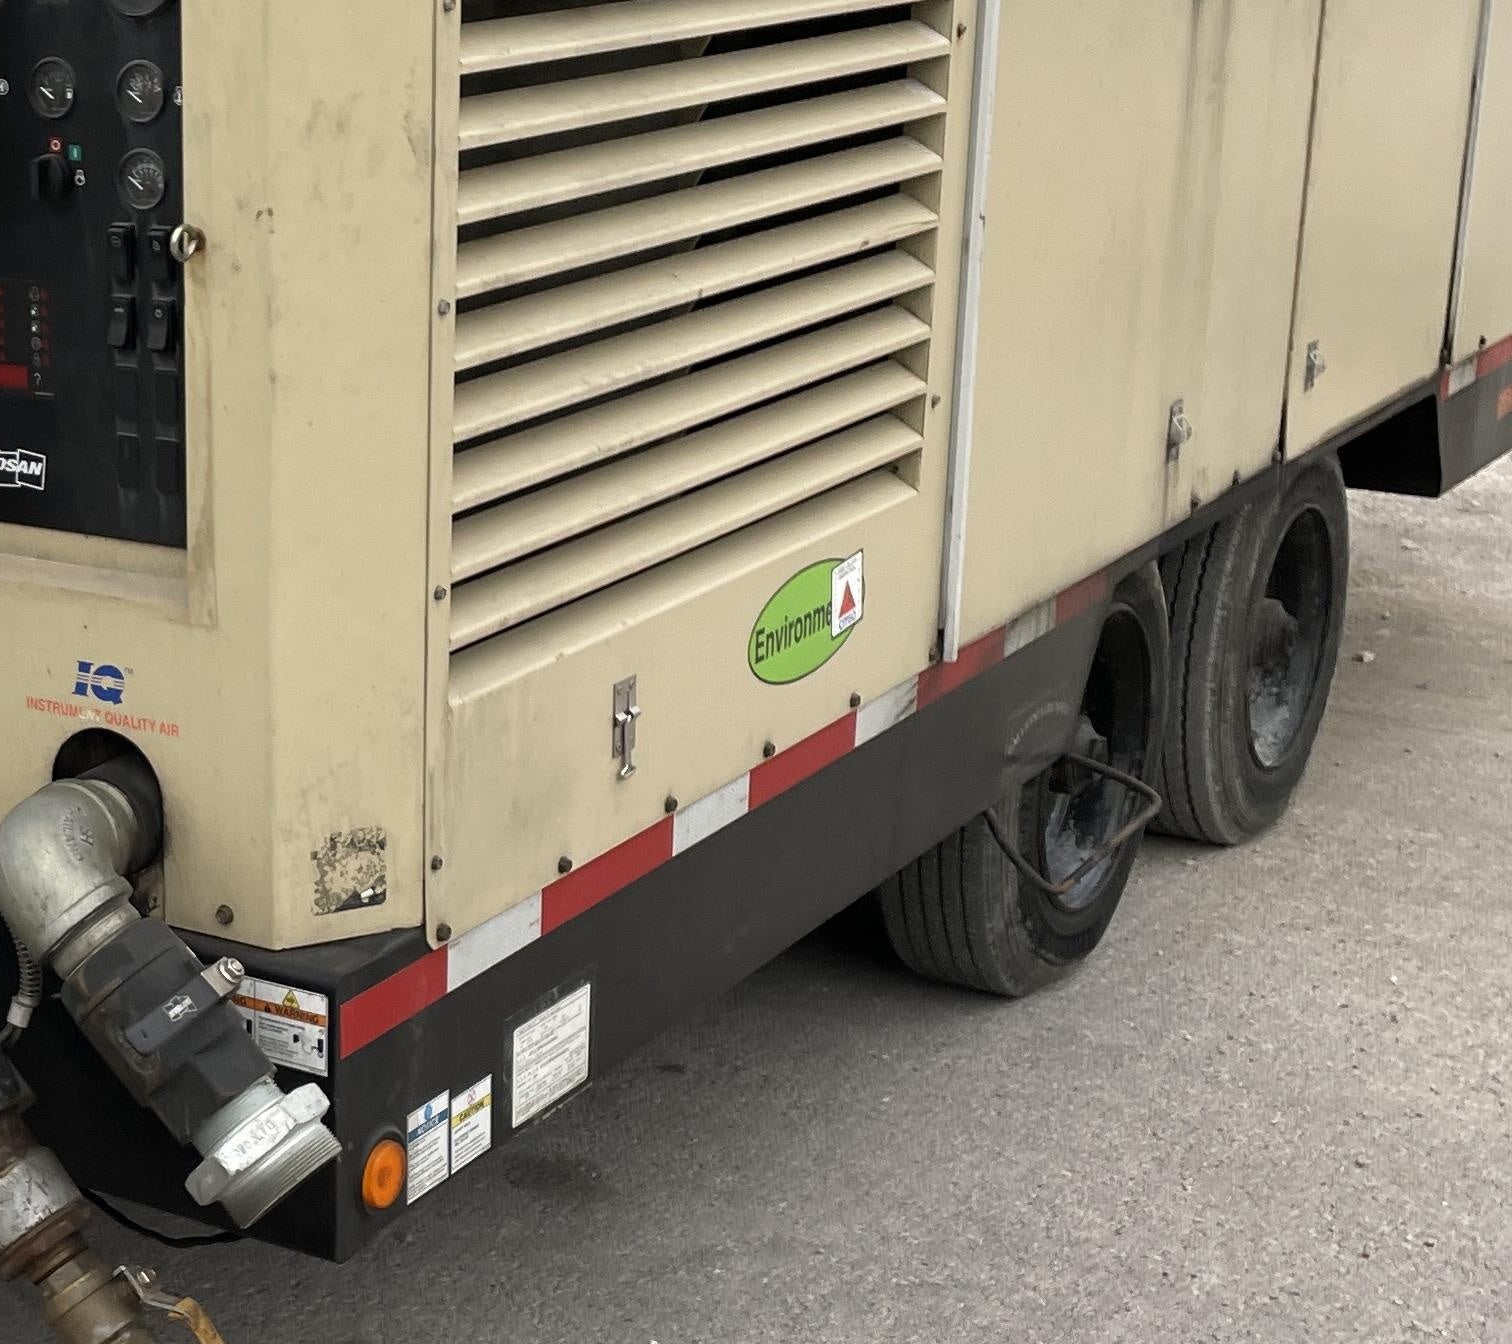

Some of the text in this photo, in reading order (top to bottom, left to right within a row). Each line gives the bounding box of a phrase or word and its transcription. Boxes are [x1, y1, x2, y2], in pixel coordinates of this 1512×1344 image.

[72, 660, 125, 705] IQ
[104, 711, 156, 733] QUALITY
[159, 721, 179, 736] AIR
